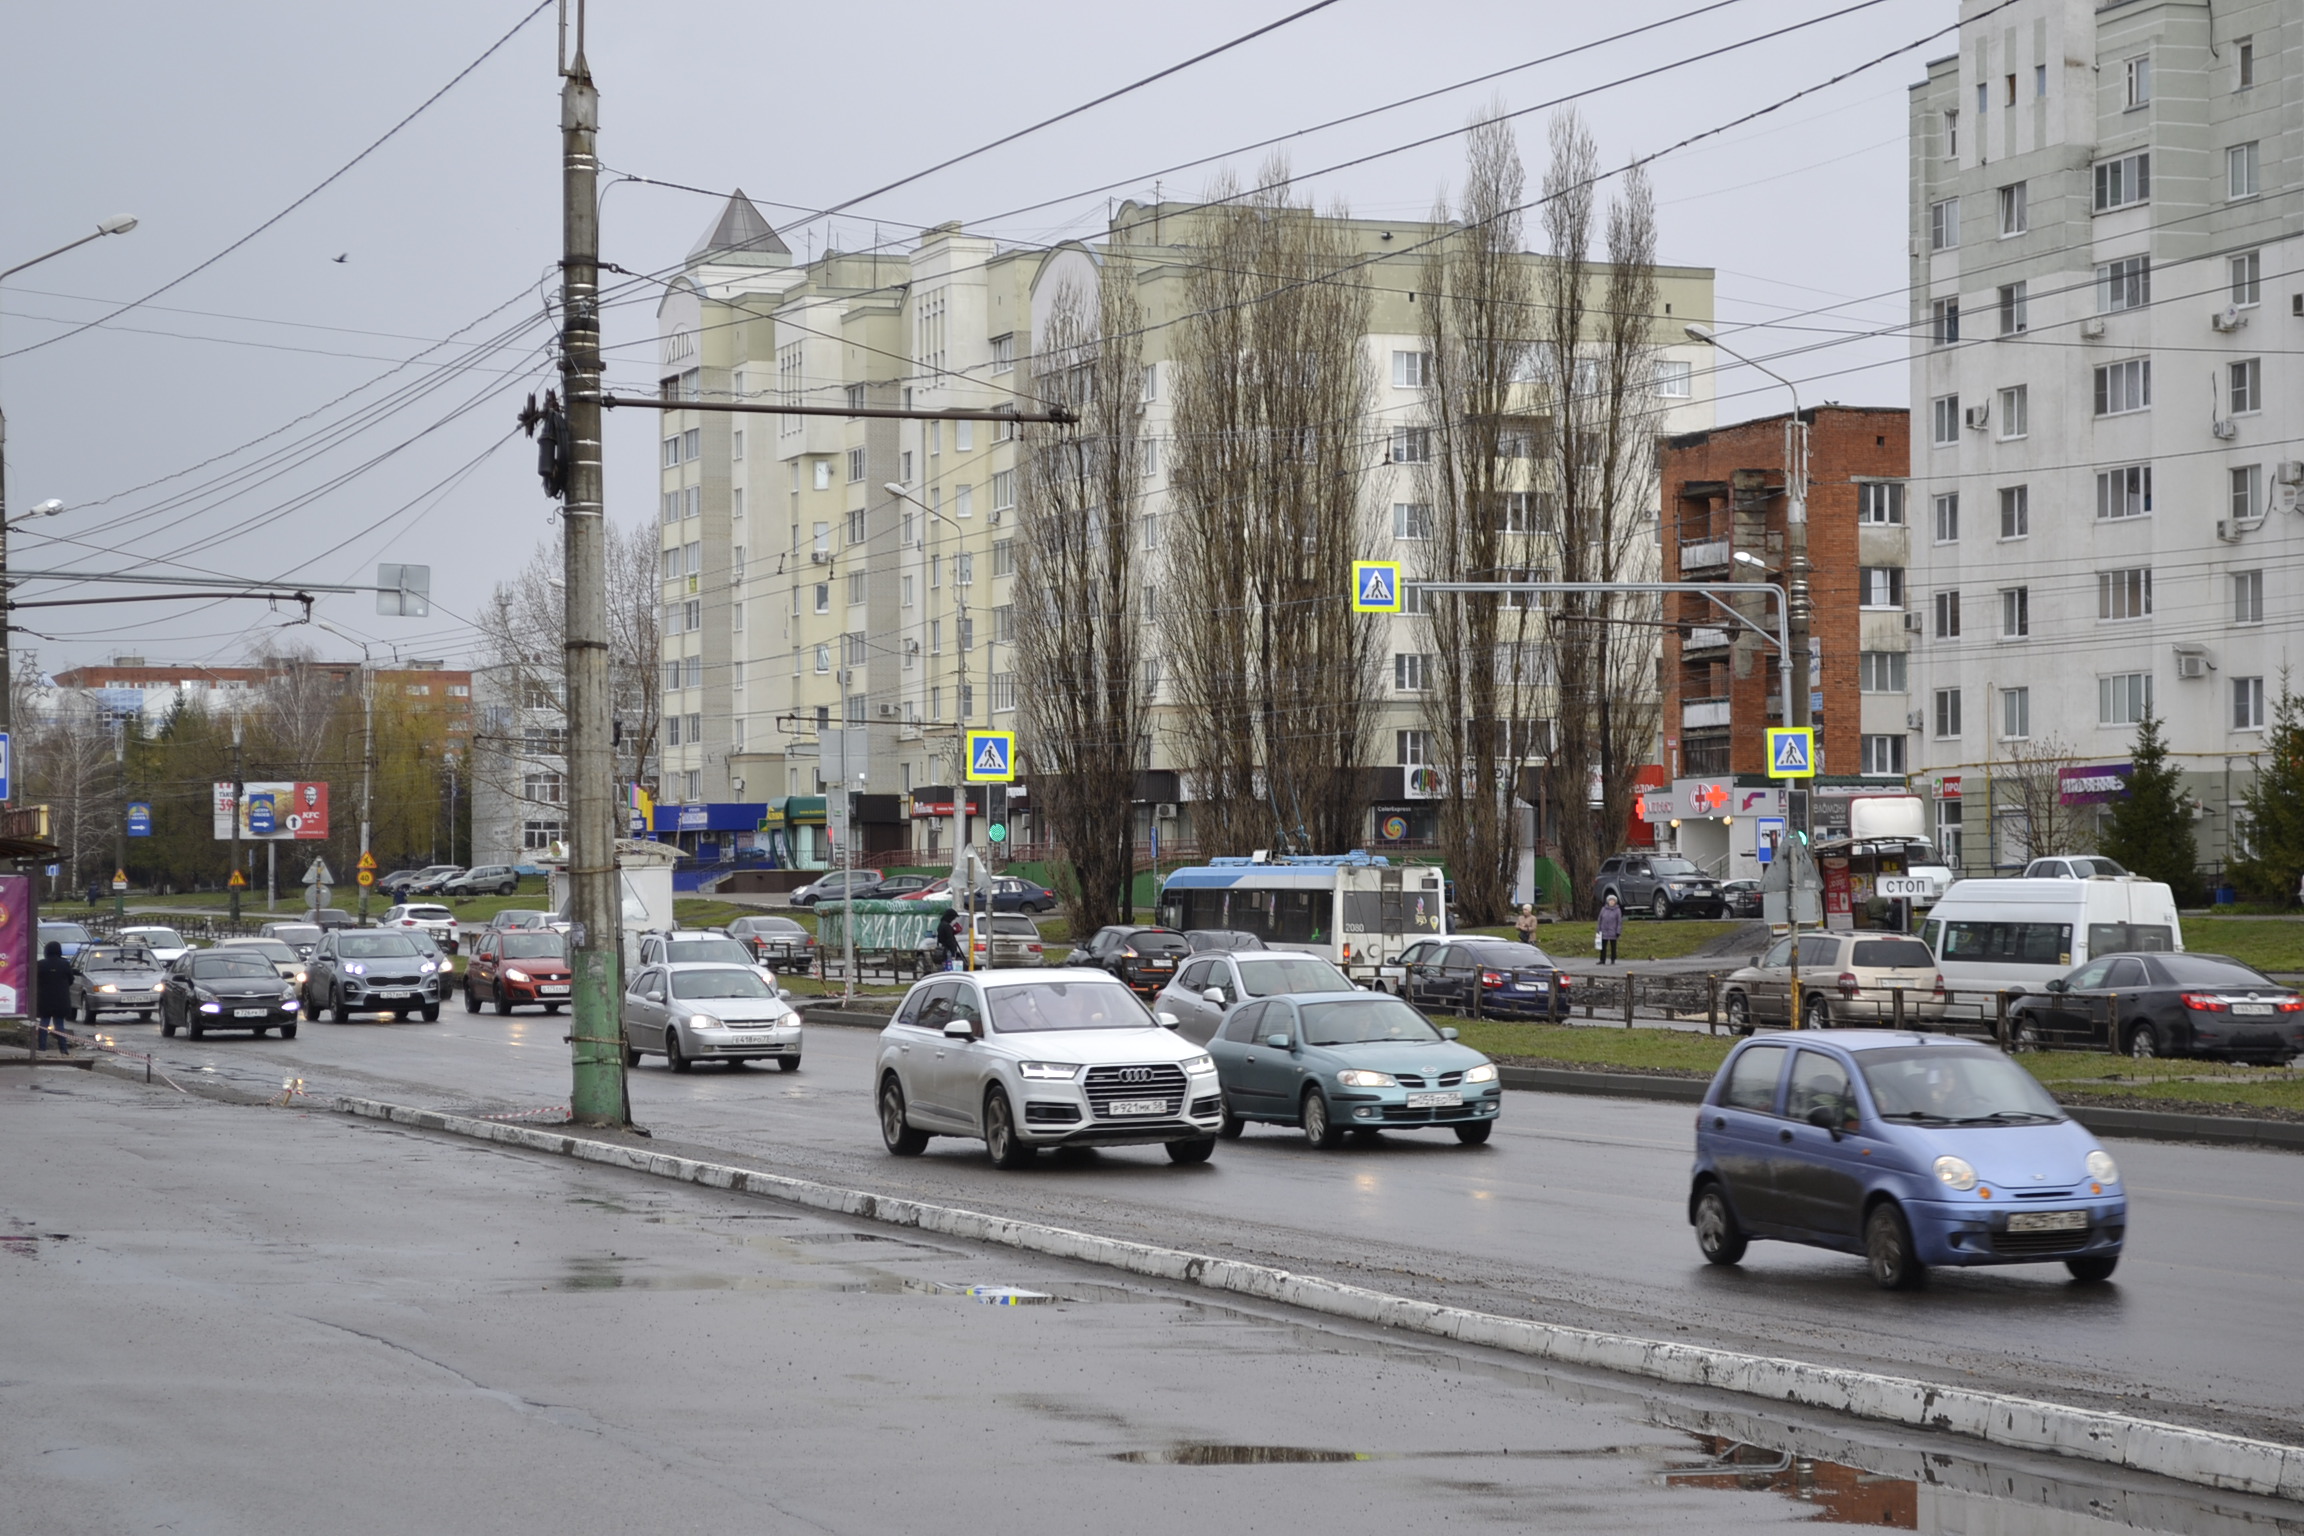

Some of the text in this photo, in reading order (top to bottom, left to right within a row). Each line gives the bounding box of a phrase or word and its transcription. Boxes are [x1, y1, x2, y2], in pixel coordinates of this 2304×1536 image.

[1377, 805, 1412, 813] ColorExpress
[302, 811, 320, 819] KFC
[1886, 880, 1925, 893] СТОП
